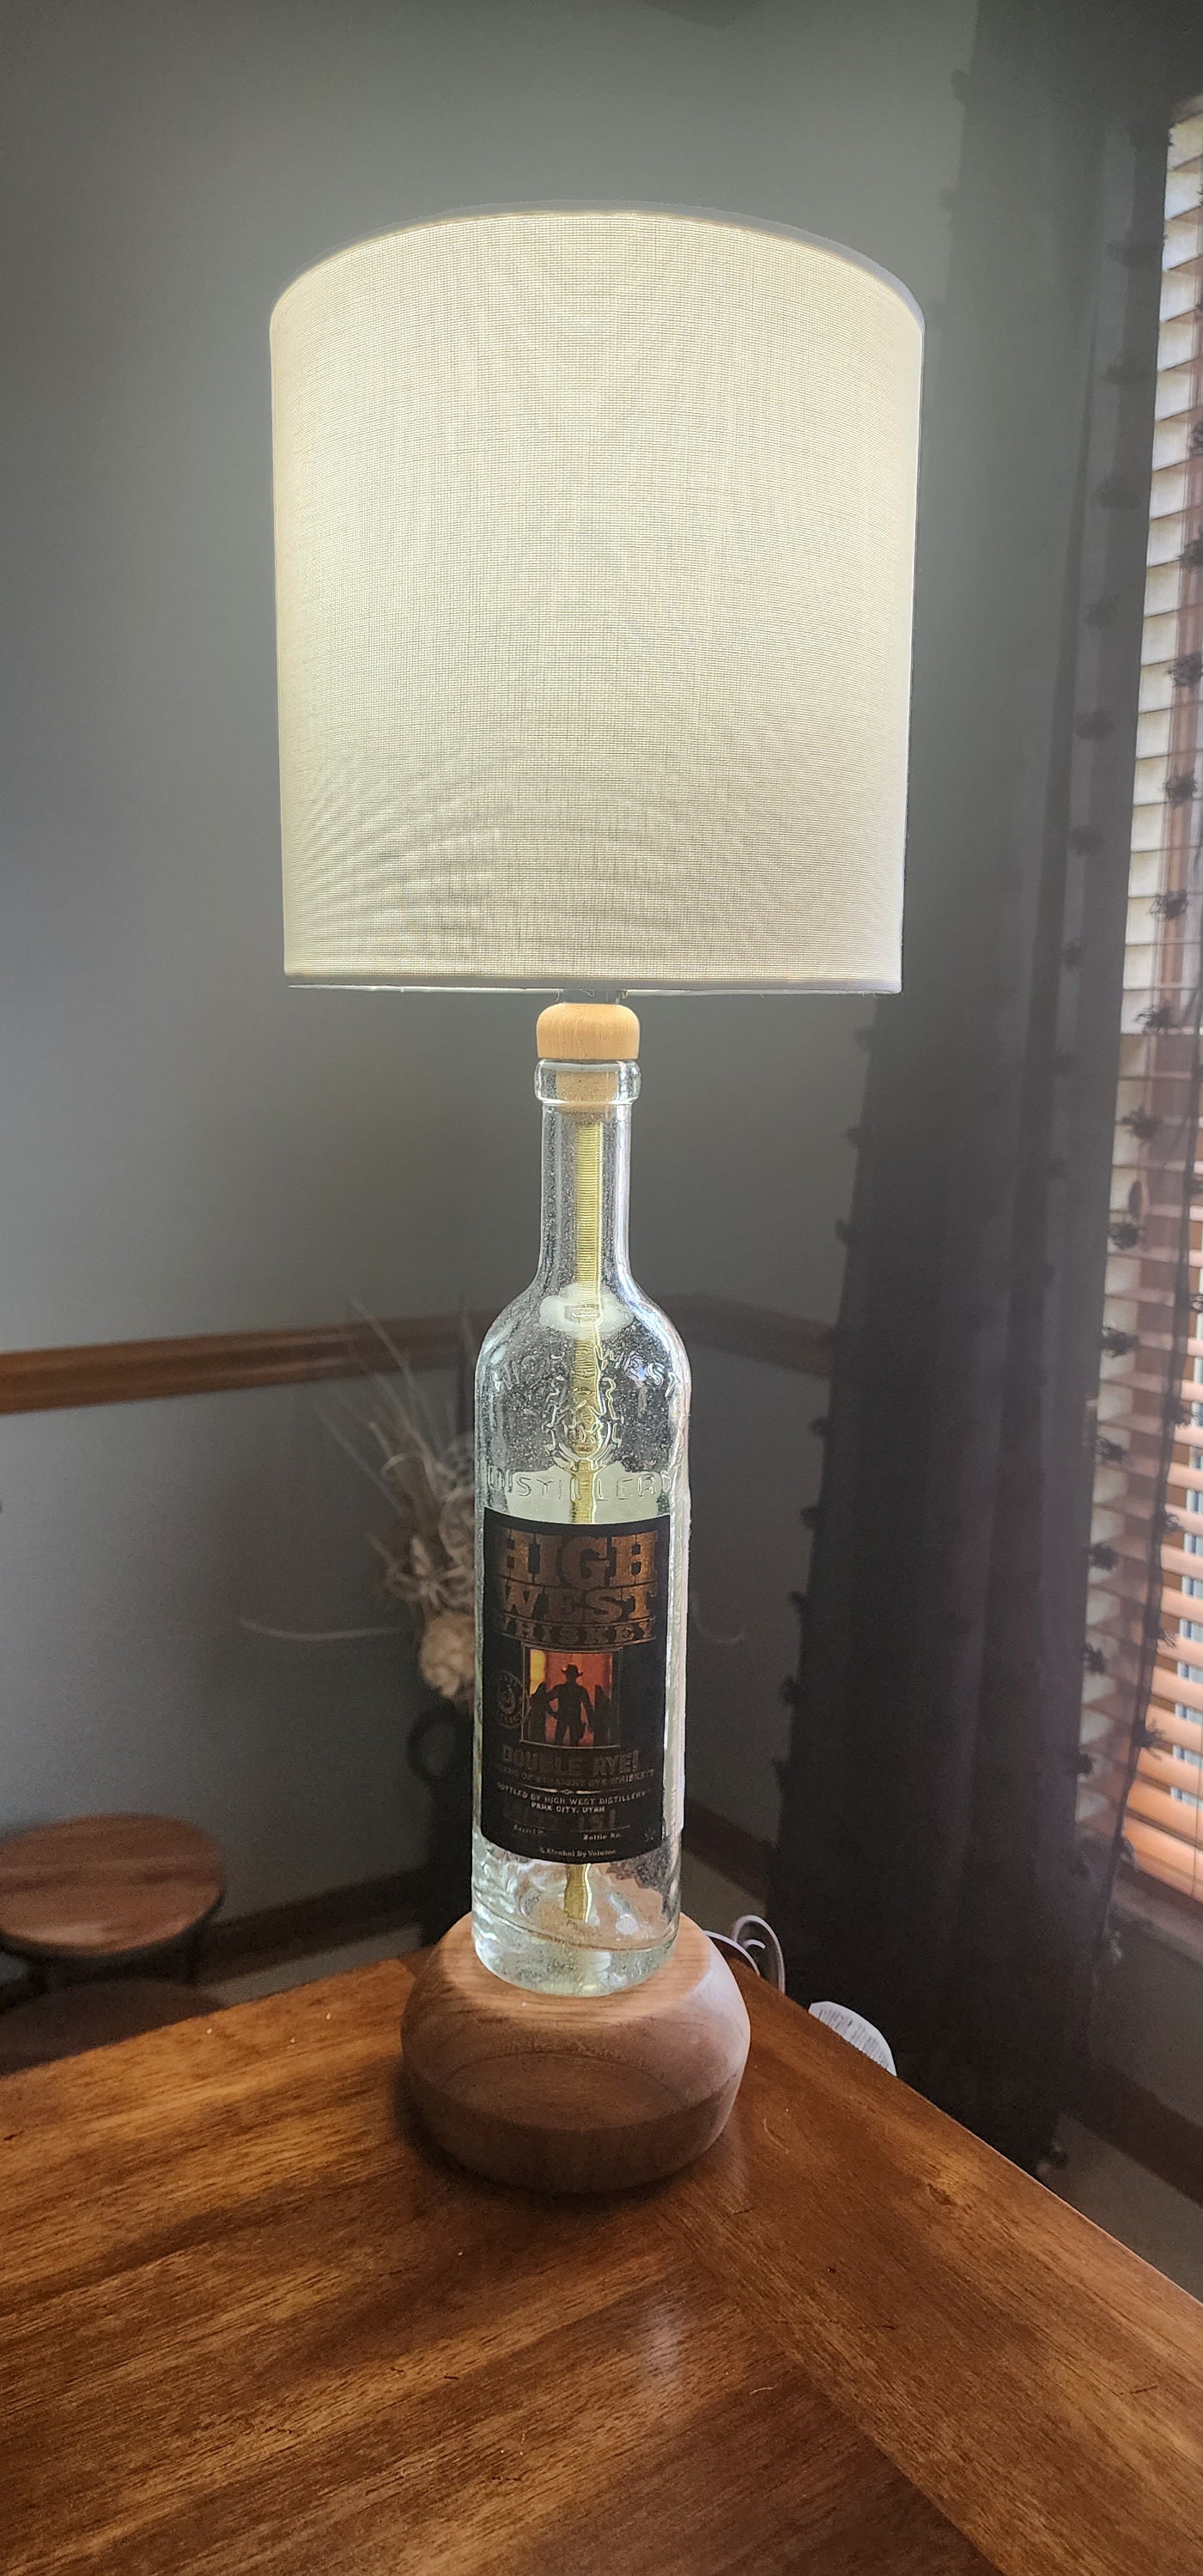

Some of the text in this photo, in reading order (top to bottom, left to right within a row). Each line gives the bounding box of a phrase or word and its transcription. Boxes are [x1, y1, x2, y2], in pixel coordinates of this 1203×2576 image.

[500, 1527, 659, 1589] HIGH
[501, 1580, 659, 1624] WEST
[500, 1615, 656, 1646] WHISKEY
[502, 1745, 584, 1776] DOUBLE
[592, 1749, 641, 1777] RYE!
[496, 1781, 528, 1799] BOTTLED
[531, 1792, 541, 1801] BY
[544, 1795, 566, 1804] HIGH
[569, 1797, 595, 1806] WEST
[532, 1801, 552, 1812] PARK
[582, 1805, 605, 1814] UTAH
[587, 1849, 617, 1857] Volume
